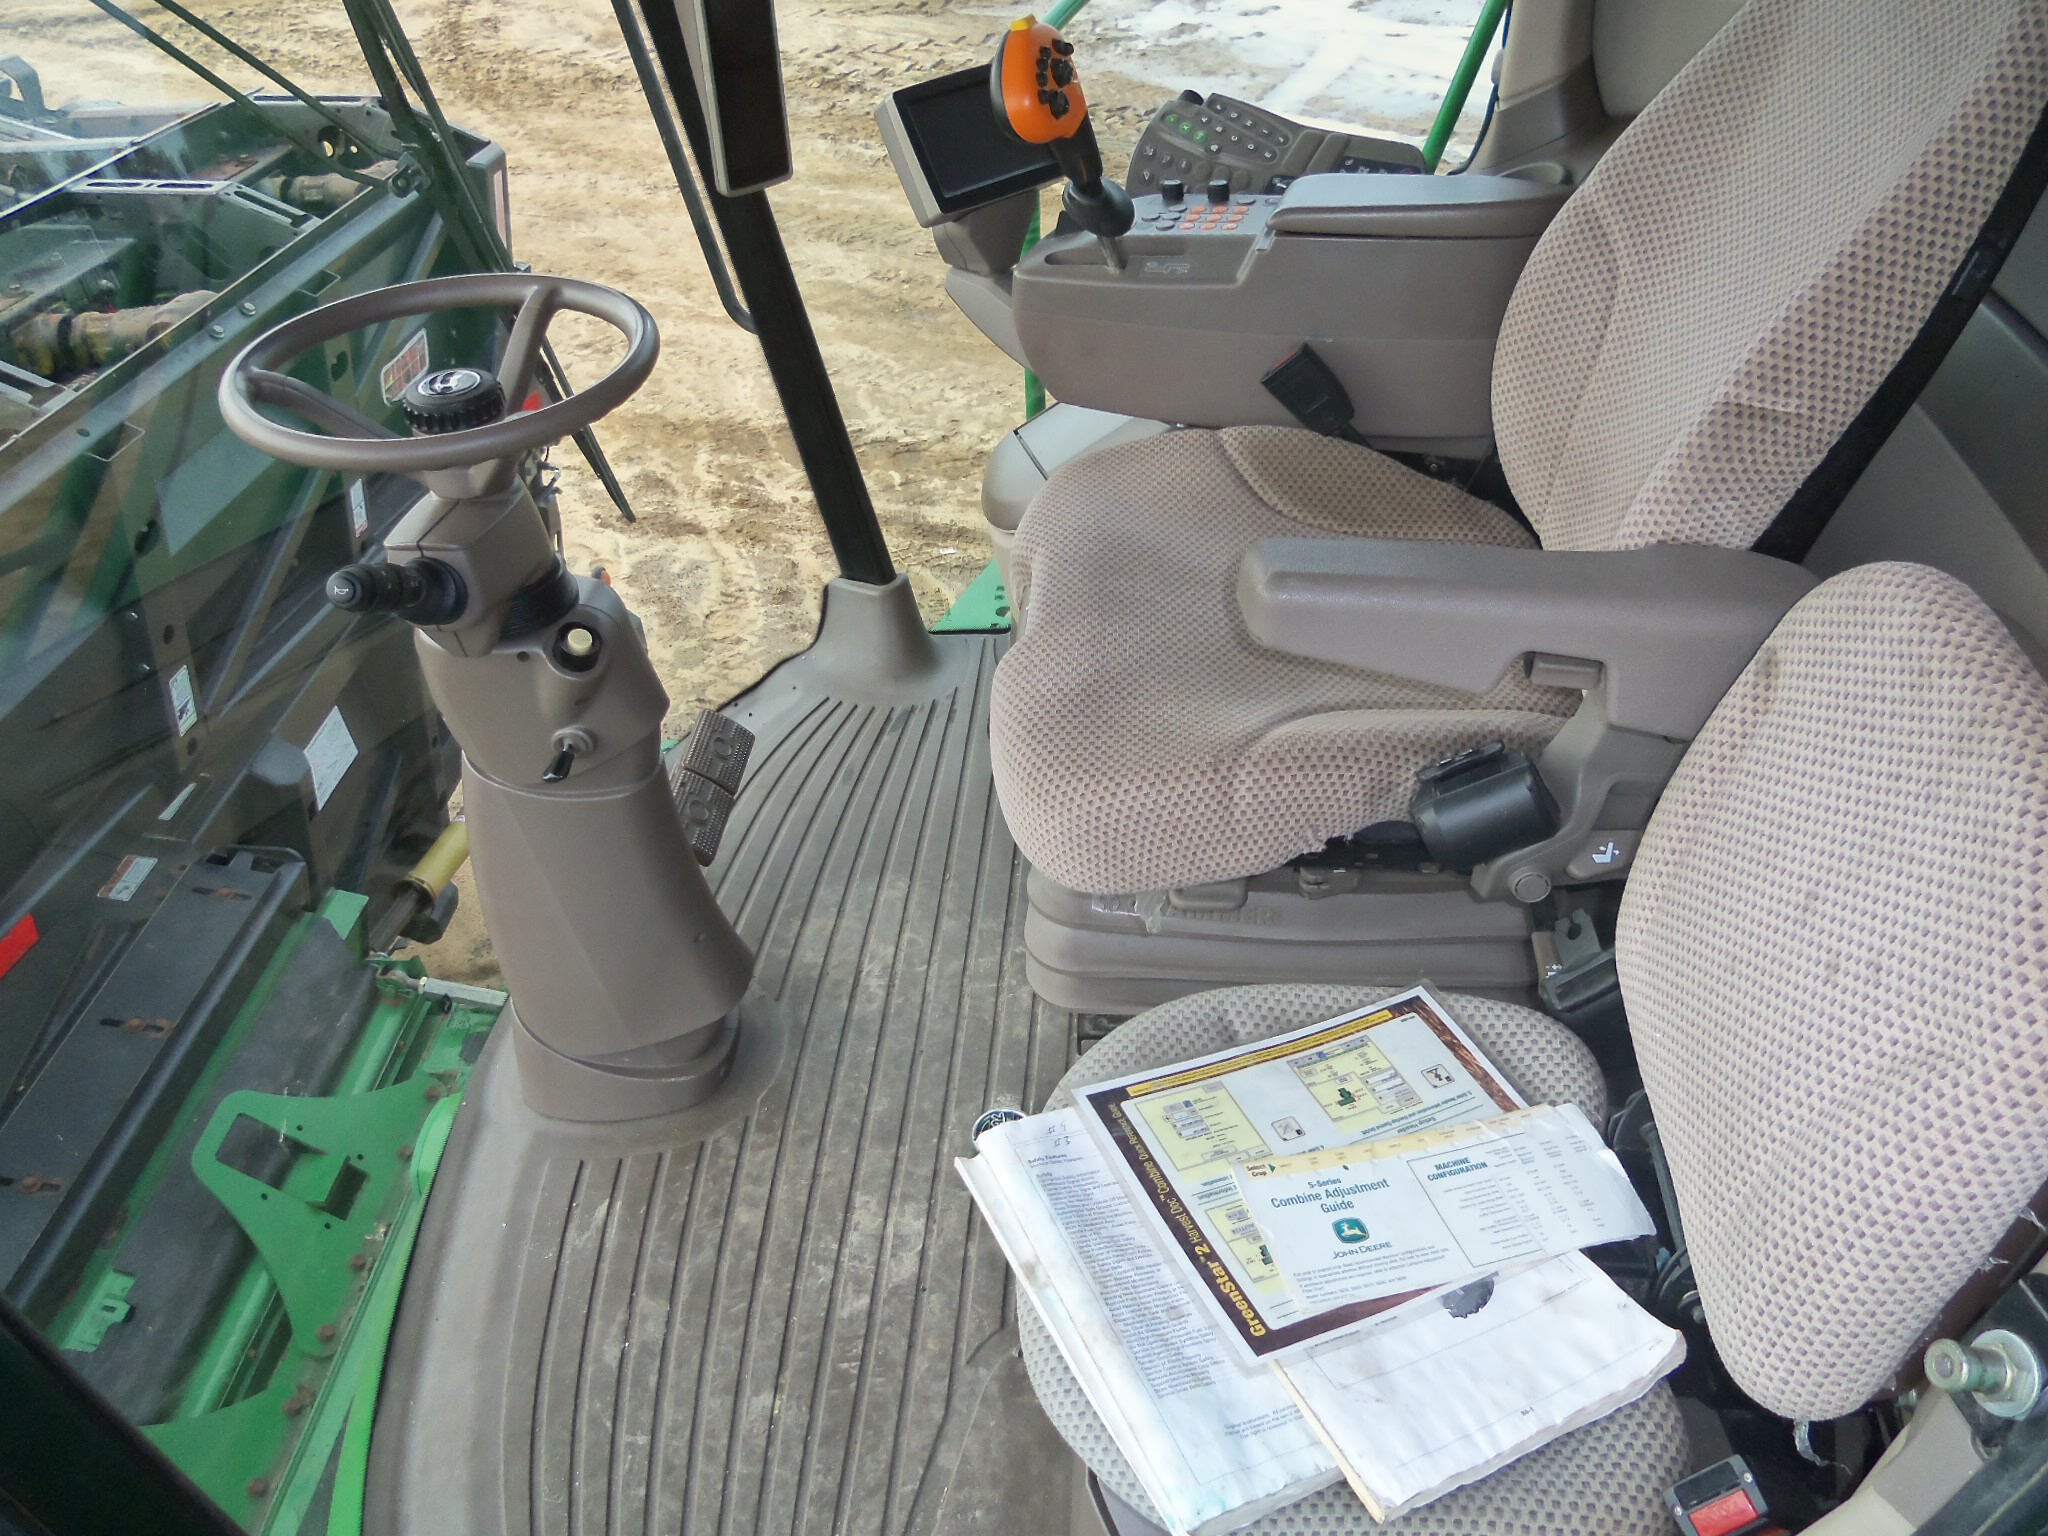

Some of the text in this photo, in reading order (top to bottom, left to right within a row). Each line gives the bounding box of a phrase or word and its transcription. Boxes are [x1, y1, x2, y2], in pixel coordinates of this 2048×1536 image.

[1246, 1163, 1266, 1173] Select
[1427, 1161, 1488, 1182] CONFIGURATION
[1435, 1157, 1471, 1171] MACHINE
[1145, 1159, 1170, 1195] Combine
[1251, 1169, 1267, 1178] Crop
[1271, 1178, 1390, 1209] Combine Adjustment
[1320, 1199, 1355, 1214] Guide
[1181, 1214, 1203, 1244] Harvest
[1195, 1245, 1211, 1258] 2
[1333, 1241, 1393, 1259] JOHN DEERE
